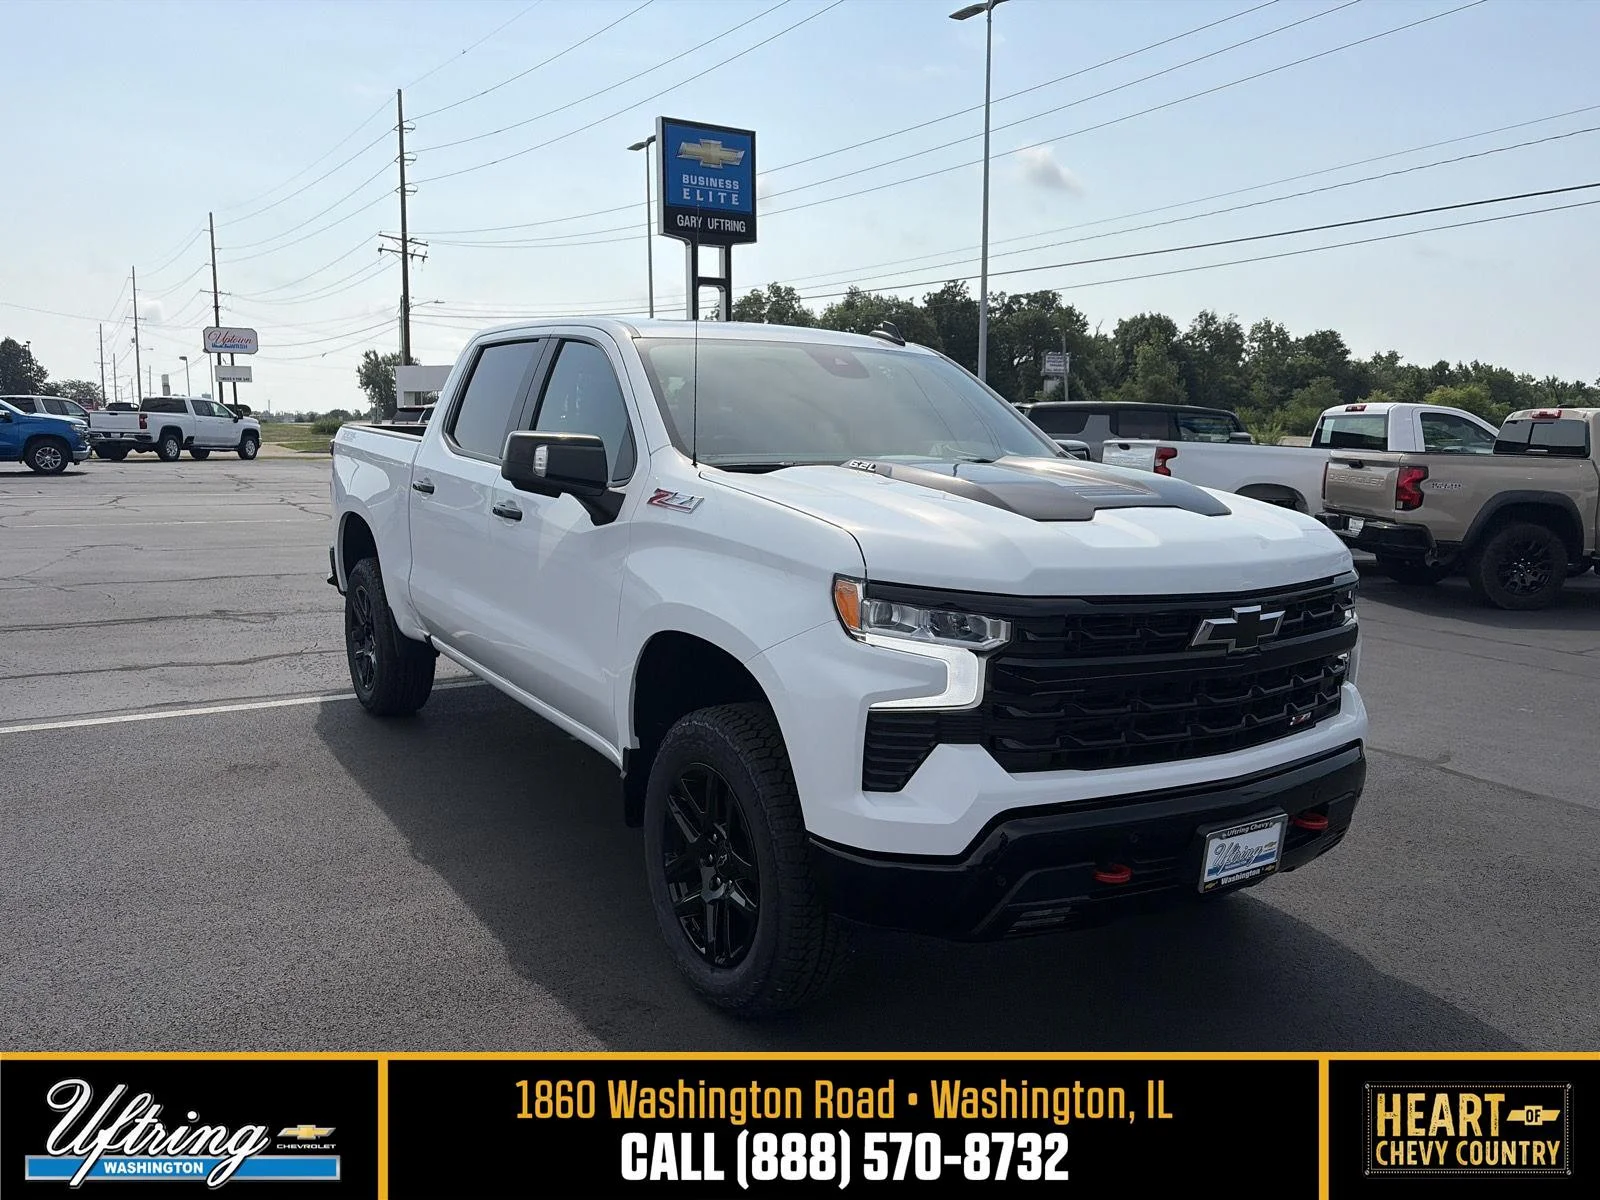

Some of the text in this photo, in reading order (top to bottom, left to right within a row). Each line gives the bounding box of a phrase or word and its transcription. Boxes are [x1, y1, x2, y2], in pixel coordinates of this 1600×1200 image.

[682, 174, 739, 190] BUSINESS
[683, 188, 739, 205] ELITE
[676, 214, 746, 233] GARY UFTRING
[208, 330, 252, 345] Uptown
[1227, 820, 1269, 838] Uftring Chevy
[1221, 868, 1261, 886] Washington
